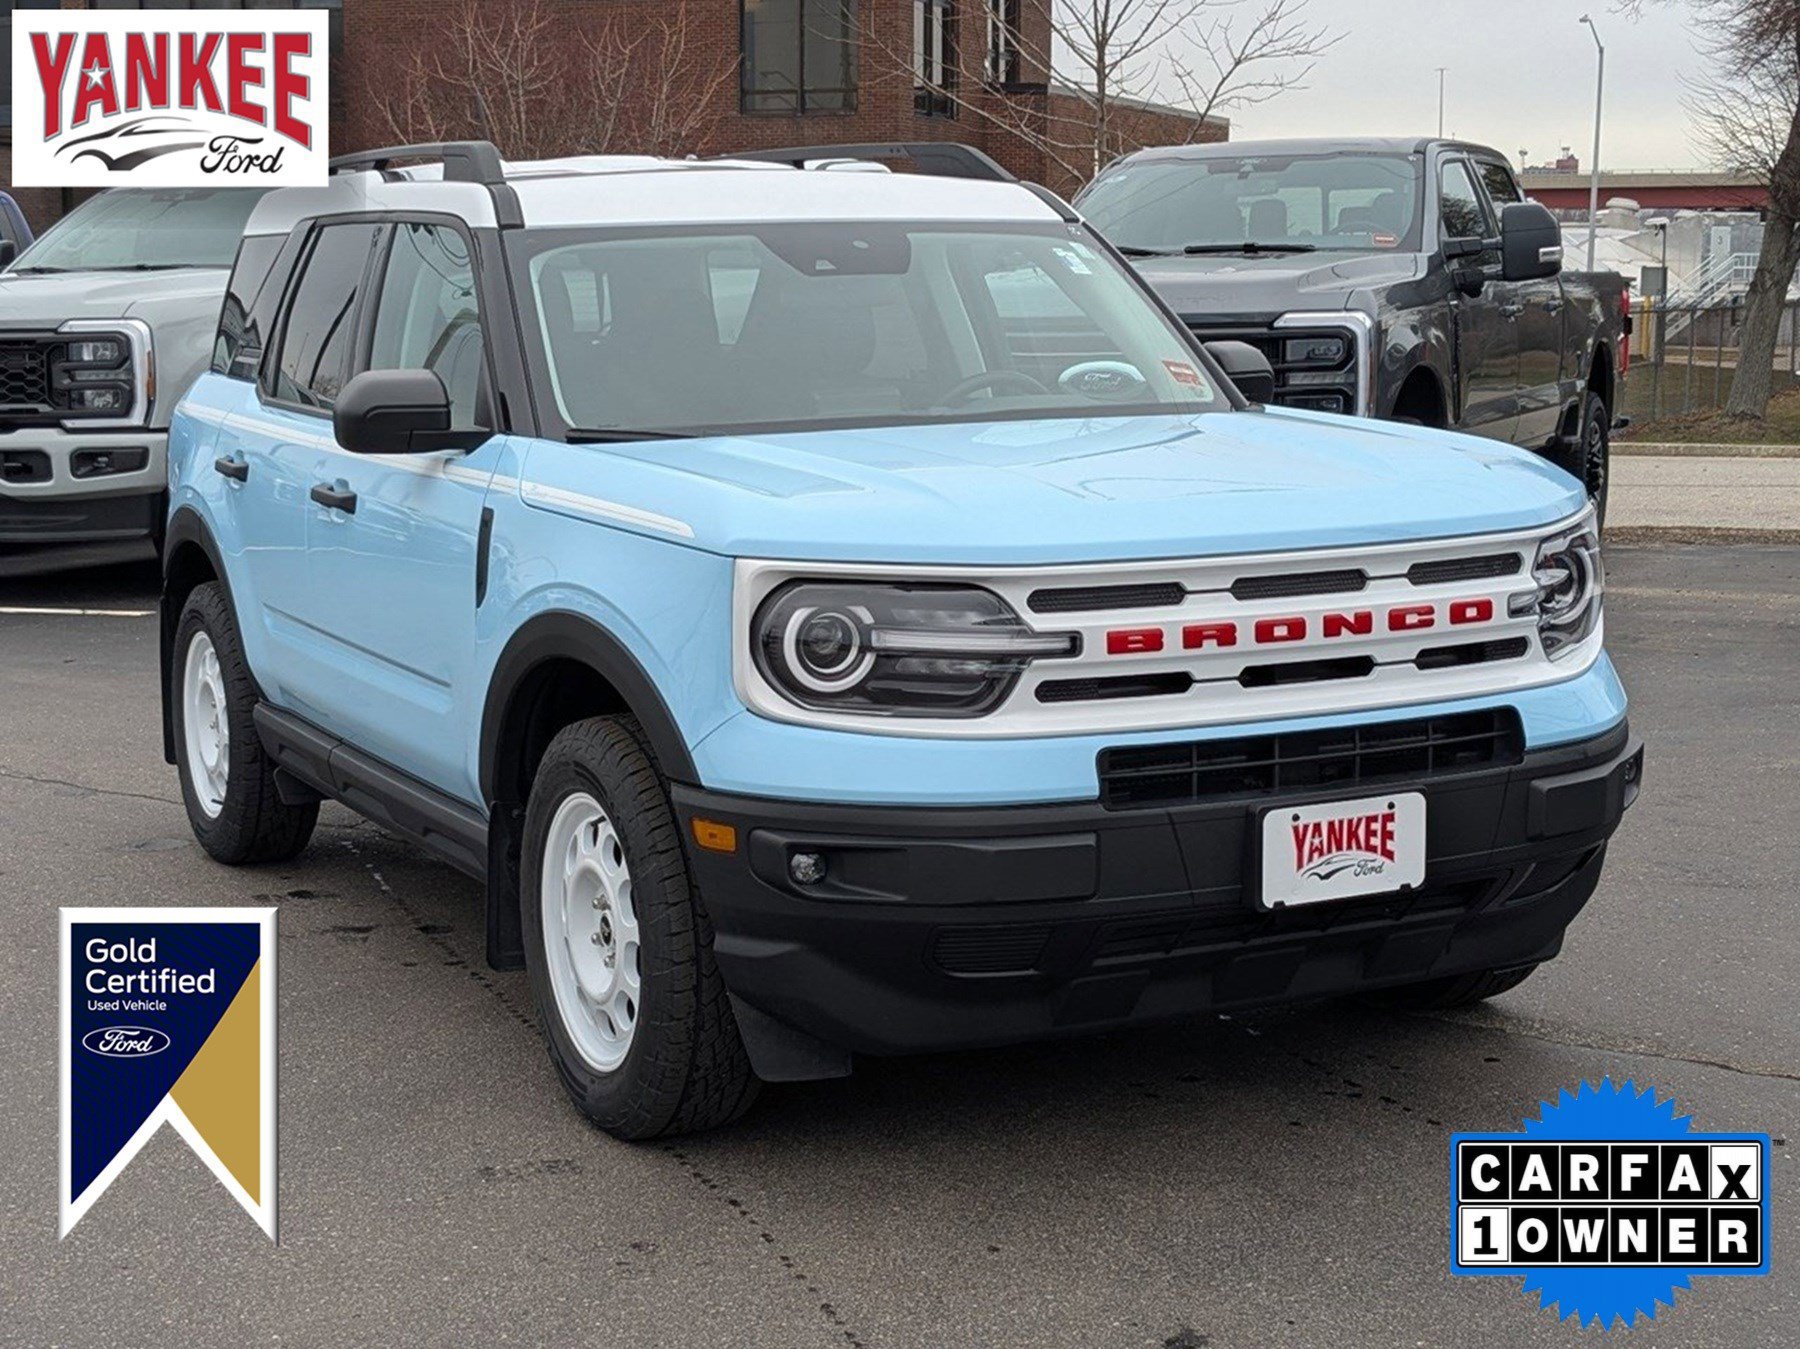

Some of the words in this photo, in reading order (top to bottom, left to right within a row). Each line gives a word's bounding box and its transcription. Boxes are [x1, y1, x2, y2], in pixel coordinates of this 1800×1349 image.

[1106, 598, 1493, 655] BRONCO
[1291, 811, 1395, 874] YANKEE
[1353, 857, 1385, 877] Ford
